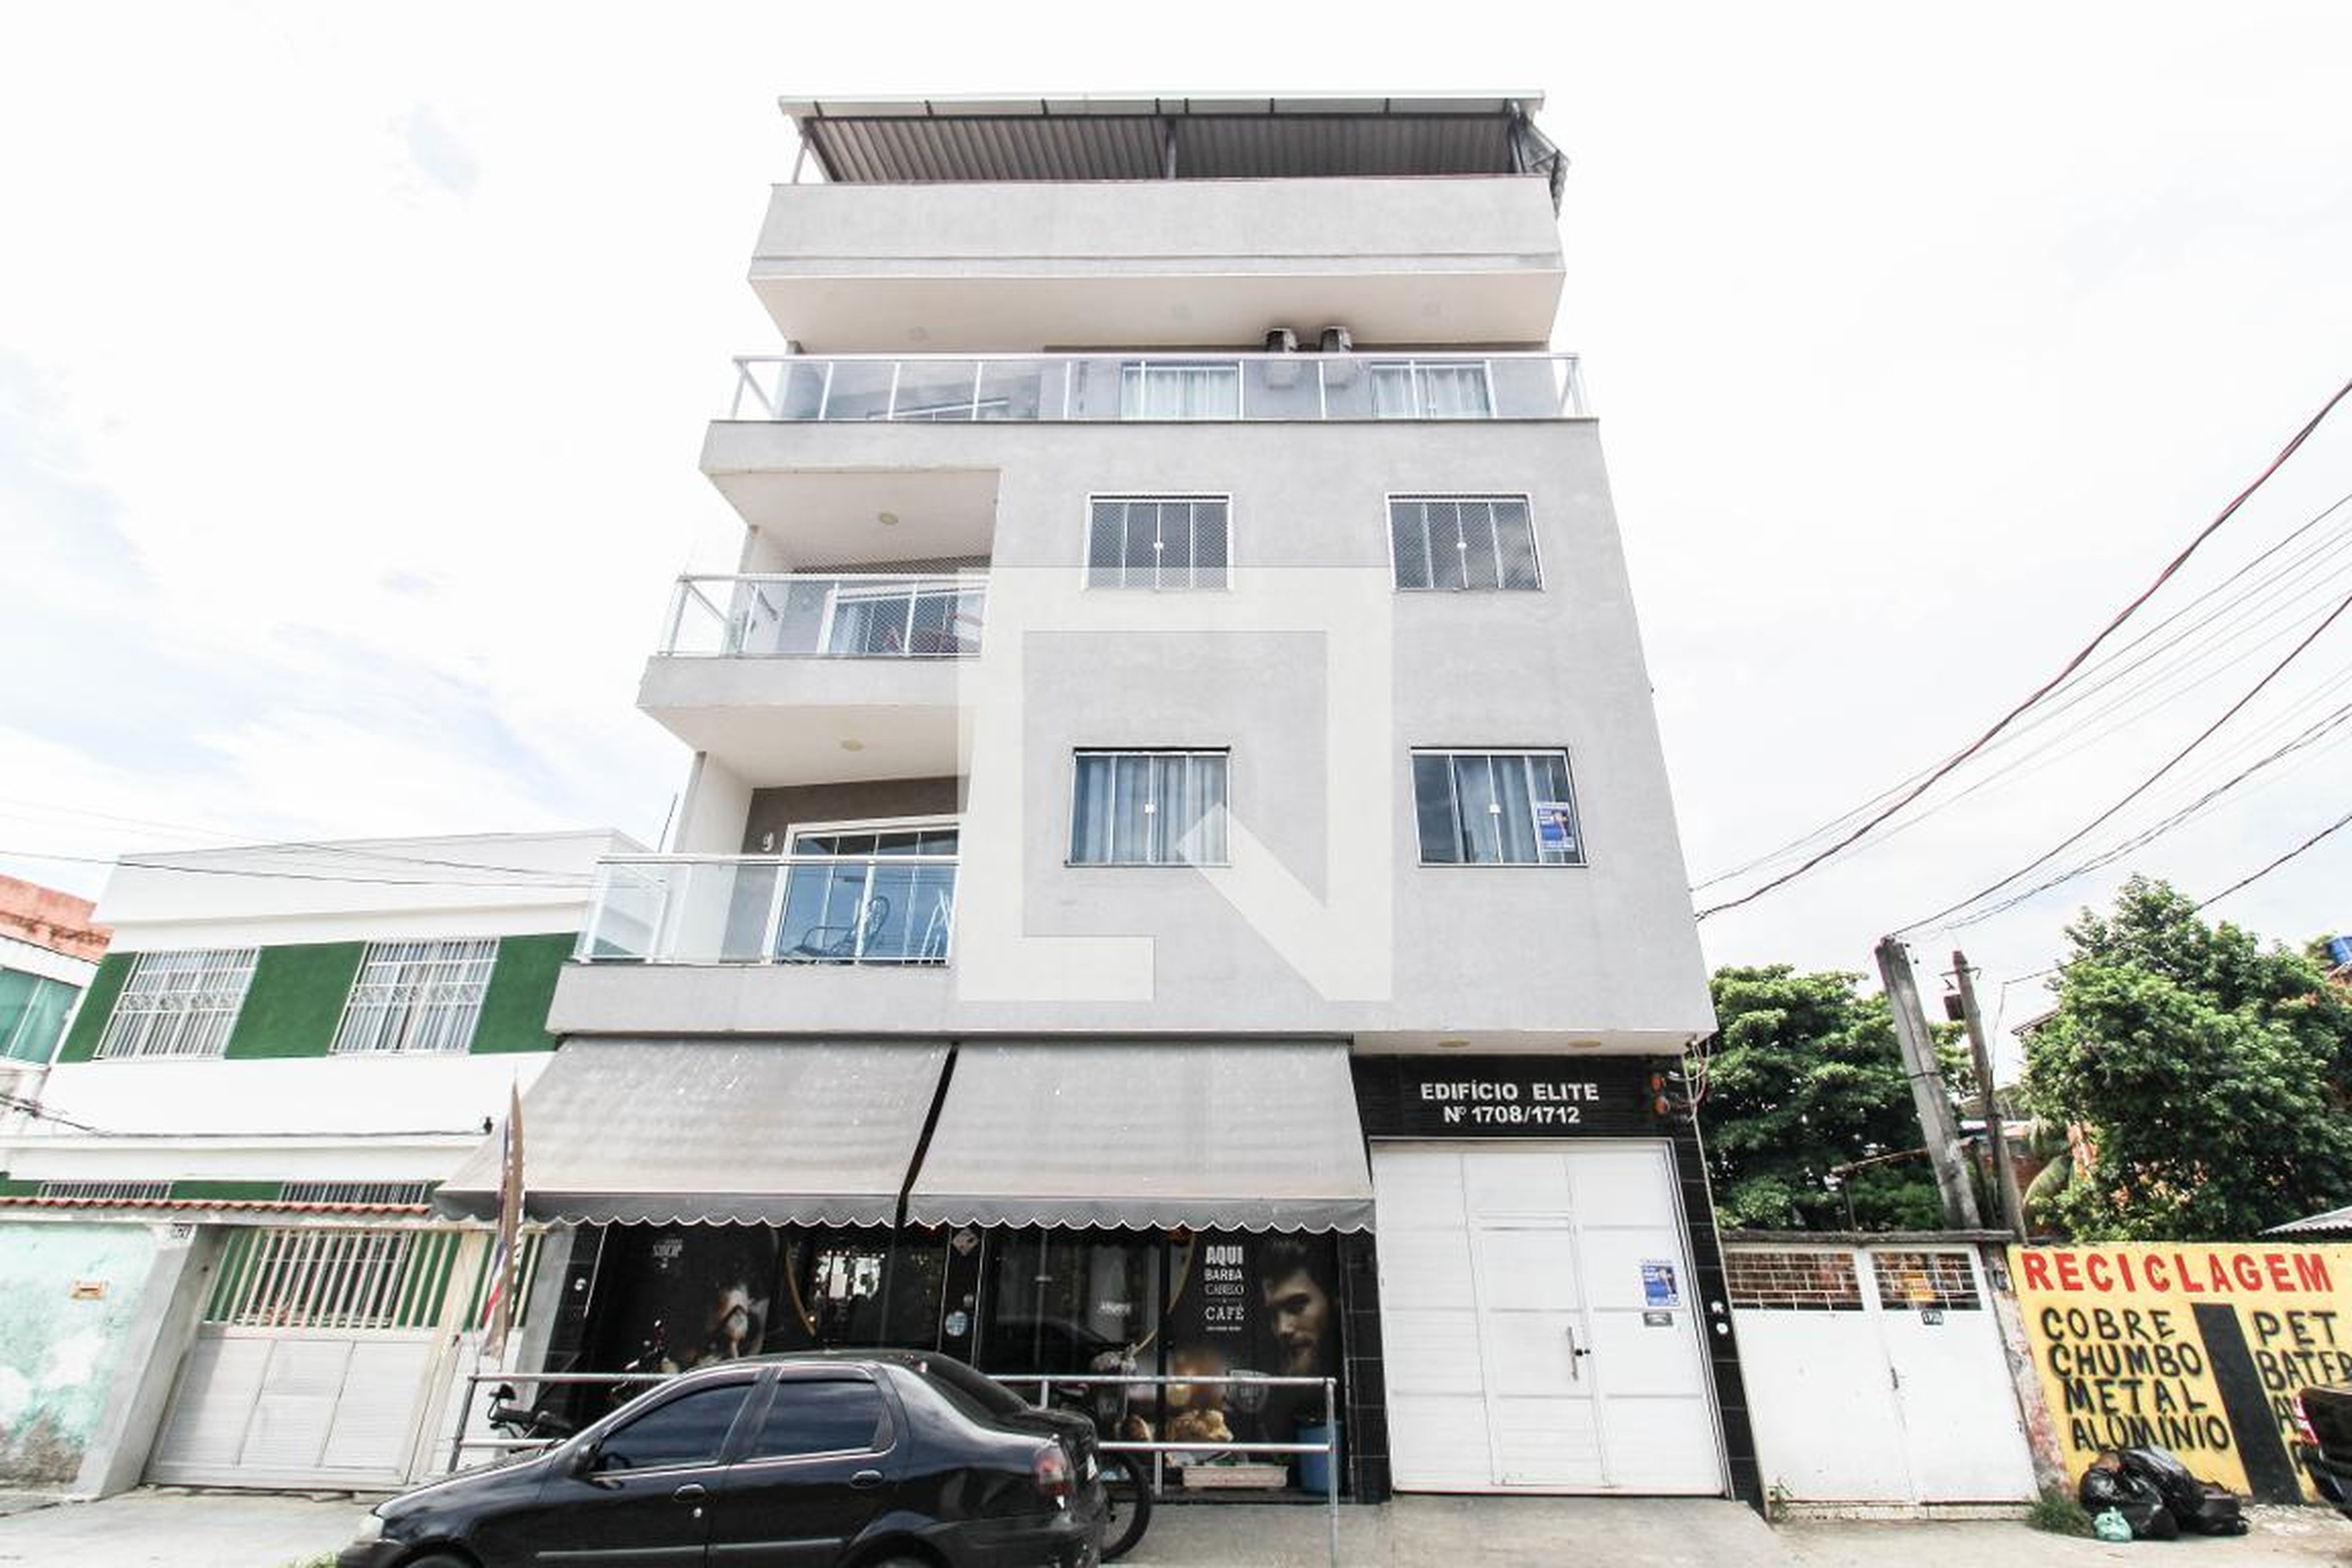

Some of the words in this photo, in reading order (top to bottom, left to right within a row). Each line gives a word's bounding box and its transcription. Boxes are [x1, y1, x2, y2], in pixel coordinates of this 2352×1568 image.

[1420, 1080, 1518, 1101] EDIFÍCIO
[1532, 1084, 1599, 1101] ELITE
[1471, 1106, 1581, 1124] 1708/1712
[1205, 1246, 1243, 1266] AQUI
[1204, 1268, 1243, 1281] BARBA
[2021, 1252, 2334, 1294] RECICLAGEM
[1205, 1303, 1245, 1321] CAFÉ
[2041, 1306, 2176, 1343] COBRE
[2253, 1310, 2337, 1347] PET
[2048, 1342, 2202, 1378] CHUMBO
[2062, 1378, 2207, 1415] METAL
